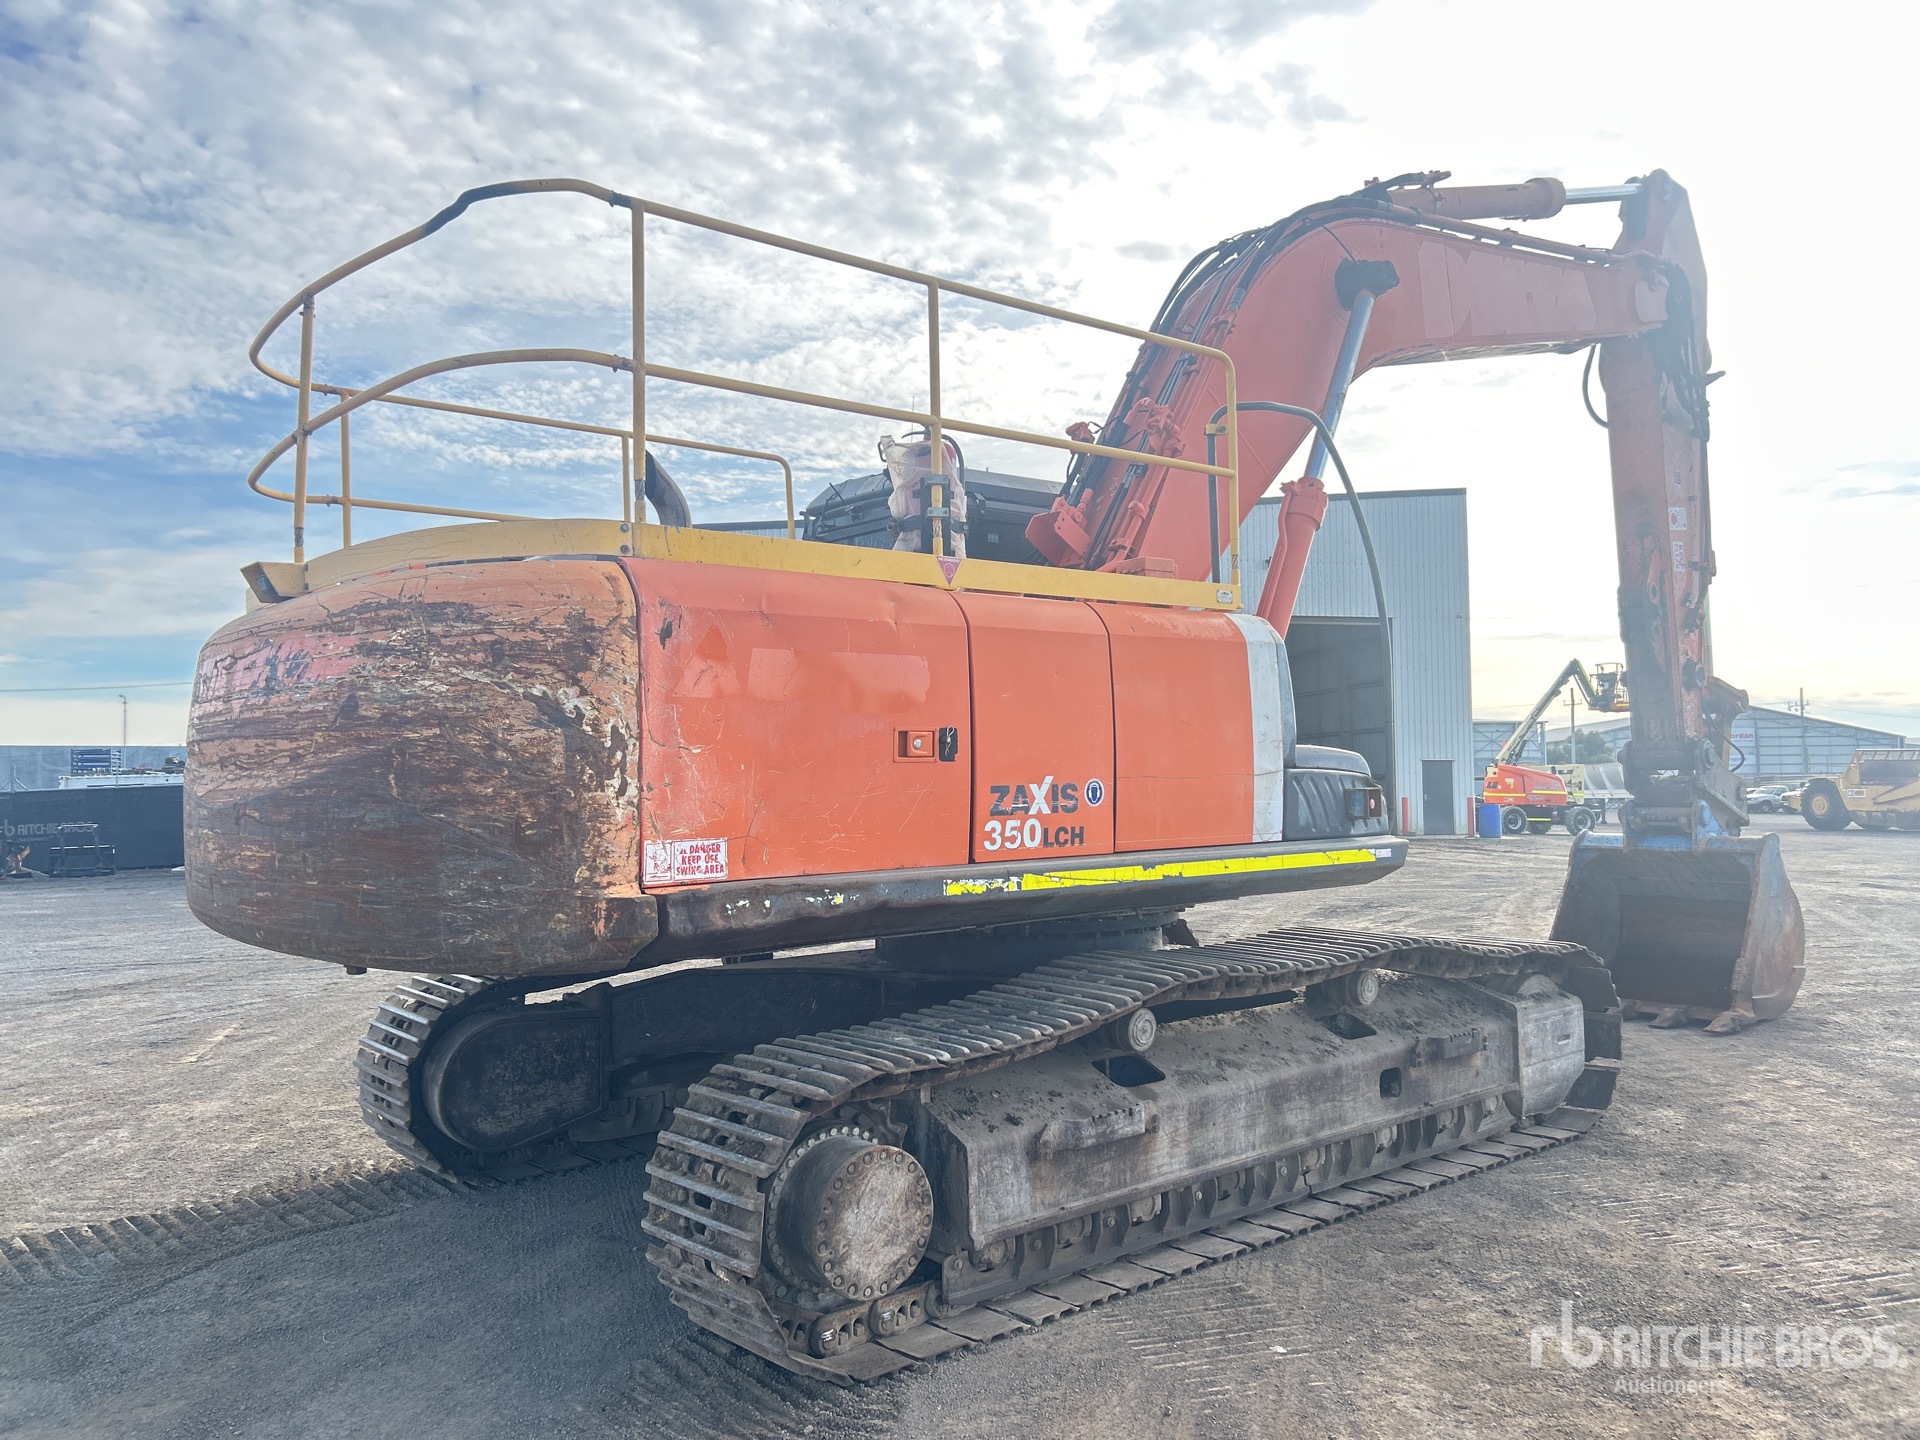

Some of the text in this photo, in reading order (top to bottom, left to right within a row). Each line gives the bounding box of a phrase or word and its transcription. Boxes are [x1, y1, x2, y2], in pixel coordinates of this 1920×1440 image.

[990, 775, 1079, 817] ZAXIS
[689, 843, 721, 855] DANGER
[681, 855, 702, 866] KEEP
[703, 864, 725, 875] AREA
